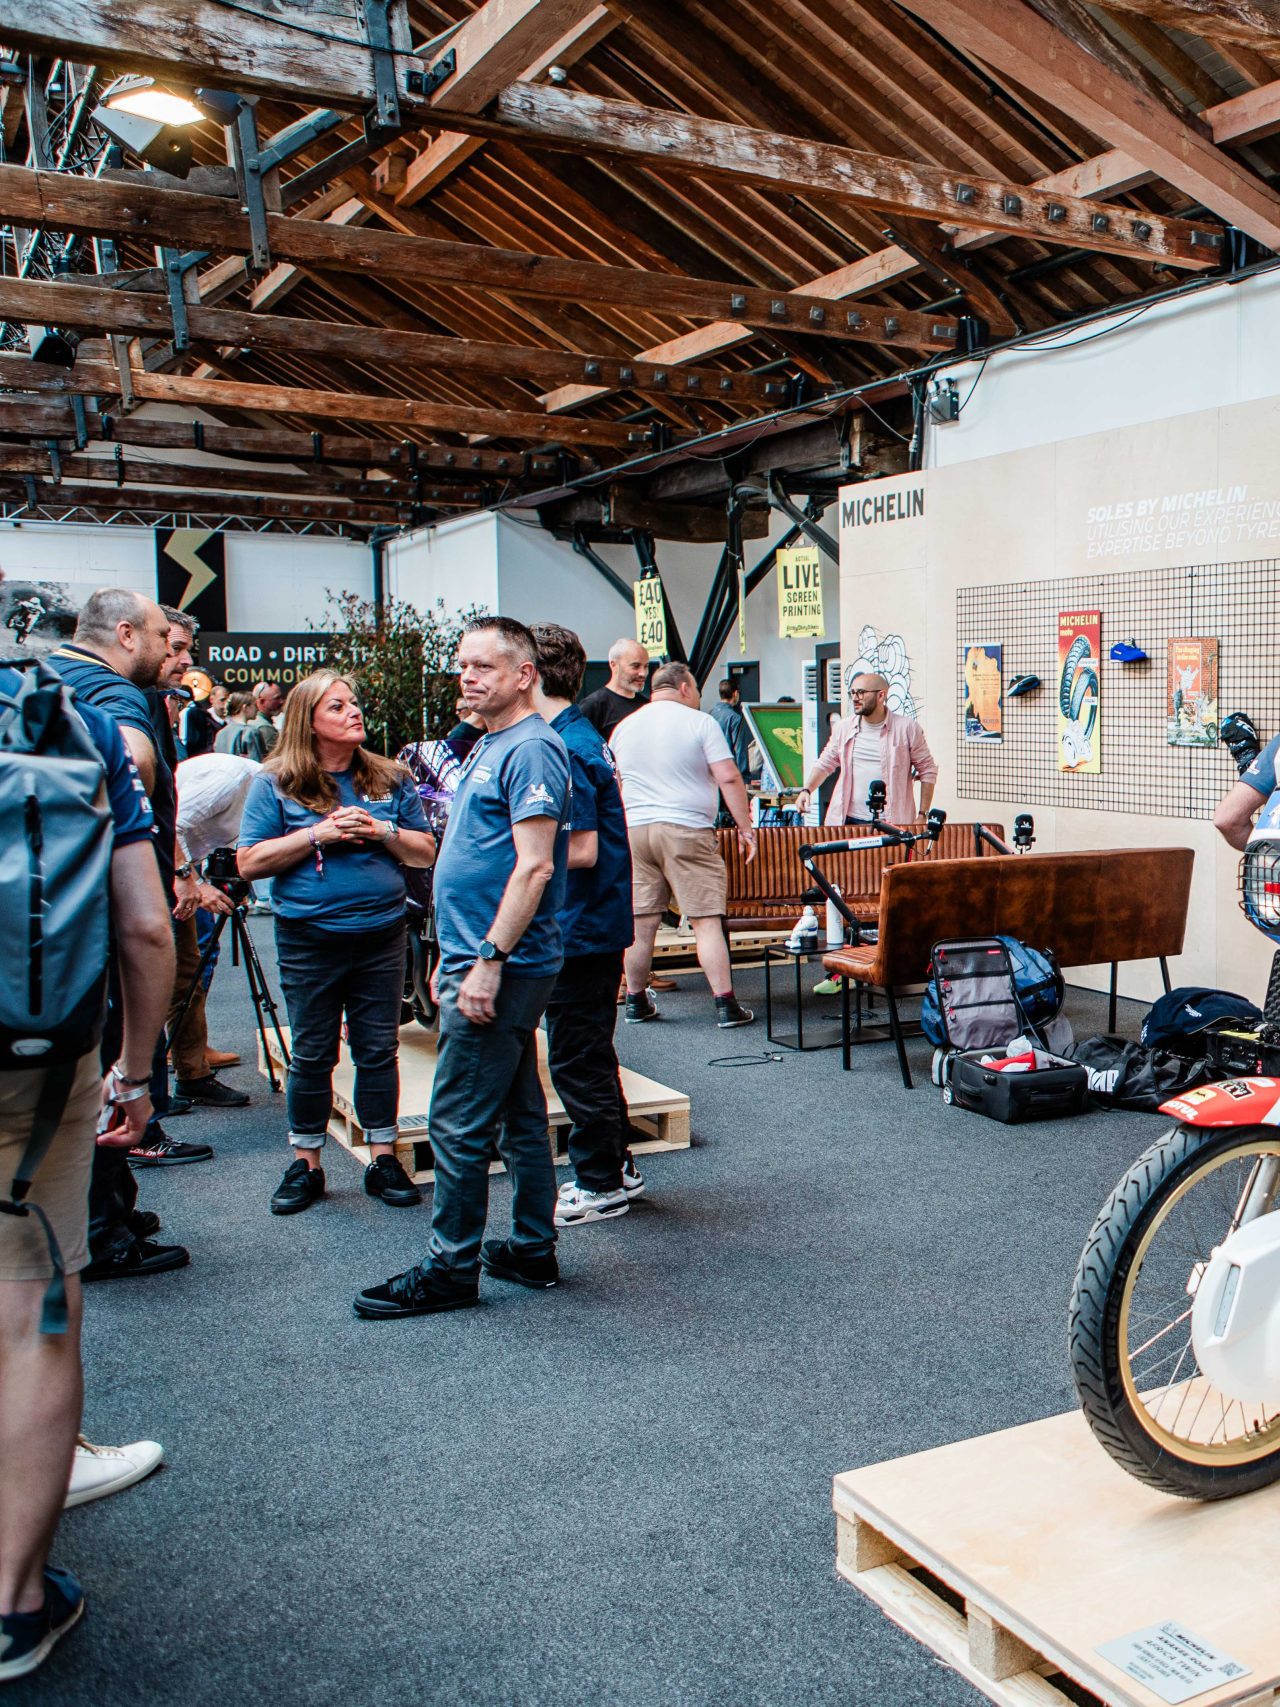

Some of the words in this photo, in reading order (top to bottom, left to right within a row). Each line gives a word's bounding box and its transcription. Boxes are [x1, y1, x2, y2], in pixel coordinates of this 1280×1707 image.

[842, 488, 925, 528] MICHELIN
[1086, 502, 1134, 523] SOLES
[1136, 498, 1158, 516] BY
[1087, 516, 1154, 541] UTILISING
[1158, 511, 1191, 532] OUR
[1087, 534, 1164, 558] EXPERTISE
[1165, 526, 1232, 550] BEYOND
[783, 563, 820, 590] LIVE
[639, 582, 661, 606] £40
[786, 590, 818, 604] SCREEN
[782, 603, 822, 617] PRINTING
[1059, 615, 1099, 627] MICHELIN
[641, 620, 663, 644] £40
[208, 646, 262, 662] ROAD
[283, 646, 328, 662] DIRT
